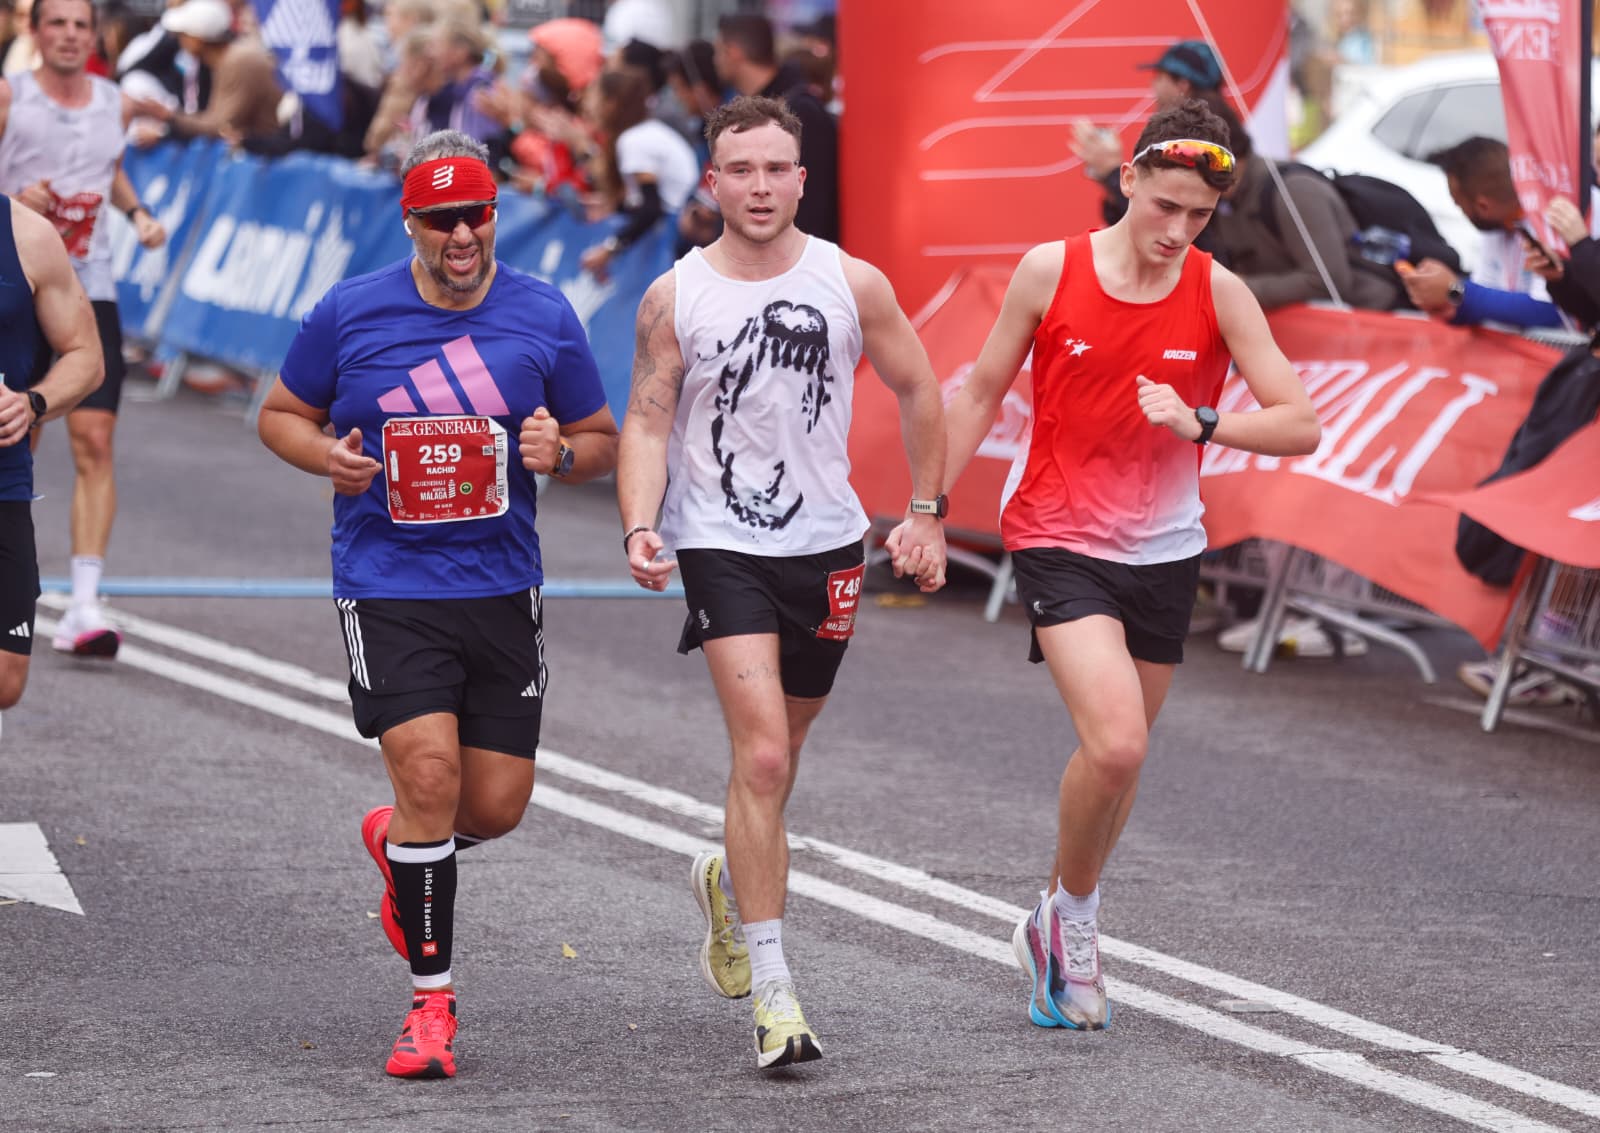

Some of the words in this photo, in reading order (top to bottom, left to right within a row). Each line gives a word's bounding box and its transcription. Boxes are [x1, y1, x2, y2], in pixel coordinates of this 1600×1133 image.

[1163, 349, 1197, 361] KAIZEN
[418, 443, 462, 464] 259
[426, 466, 456, 475] RACHID
[832, 576, 861, 599] 748
[424, 867, 433, 940] COMPRESSPORT
